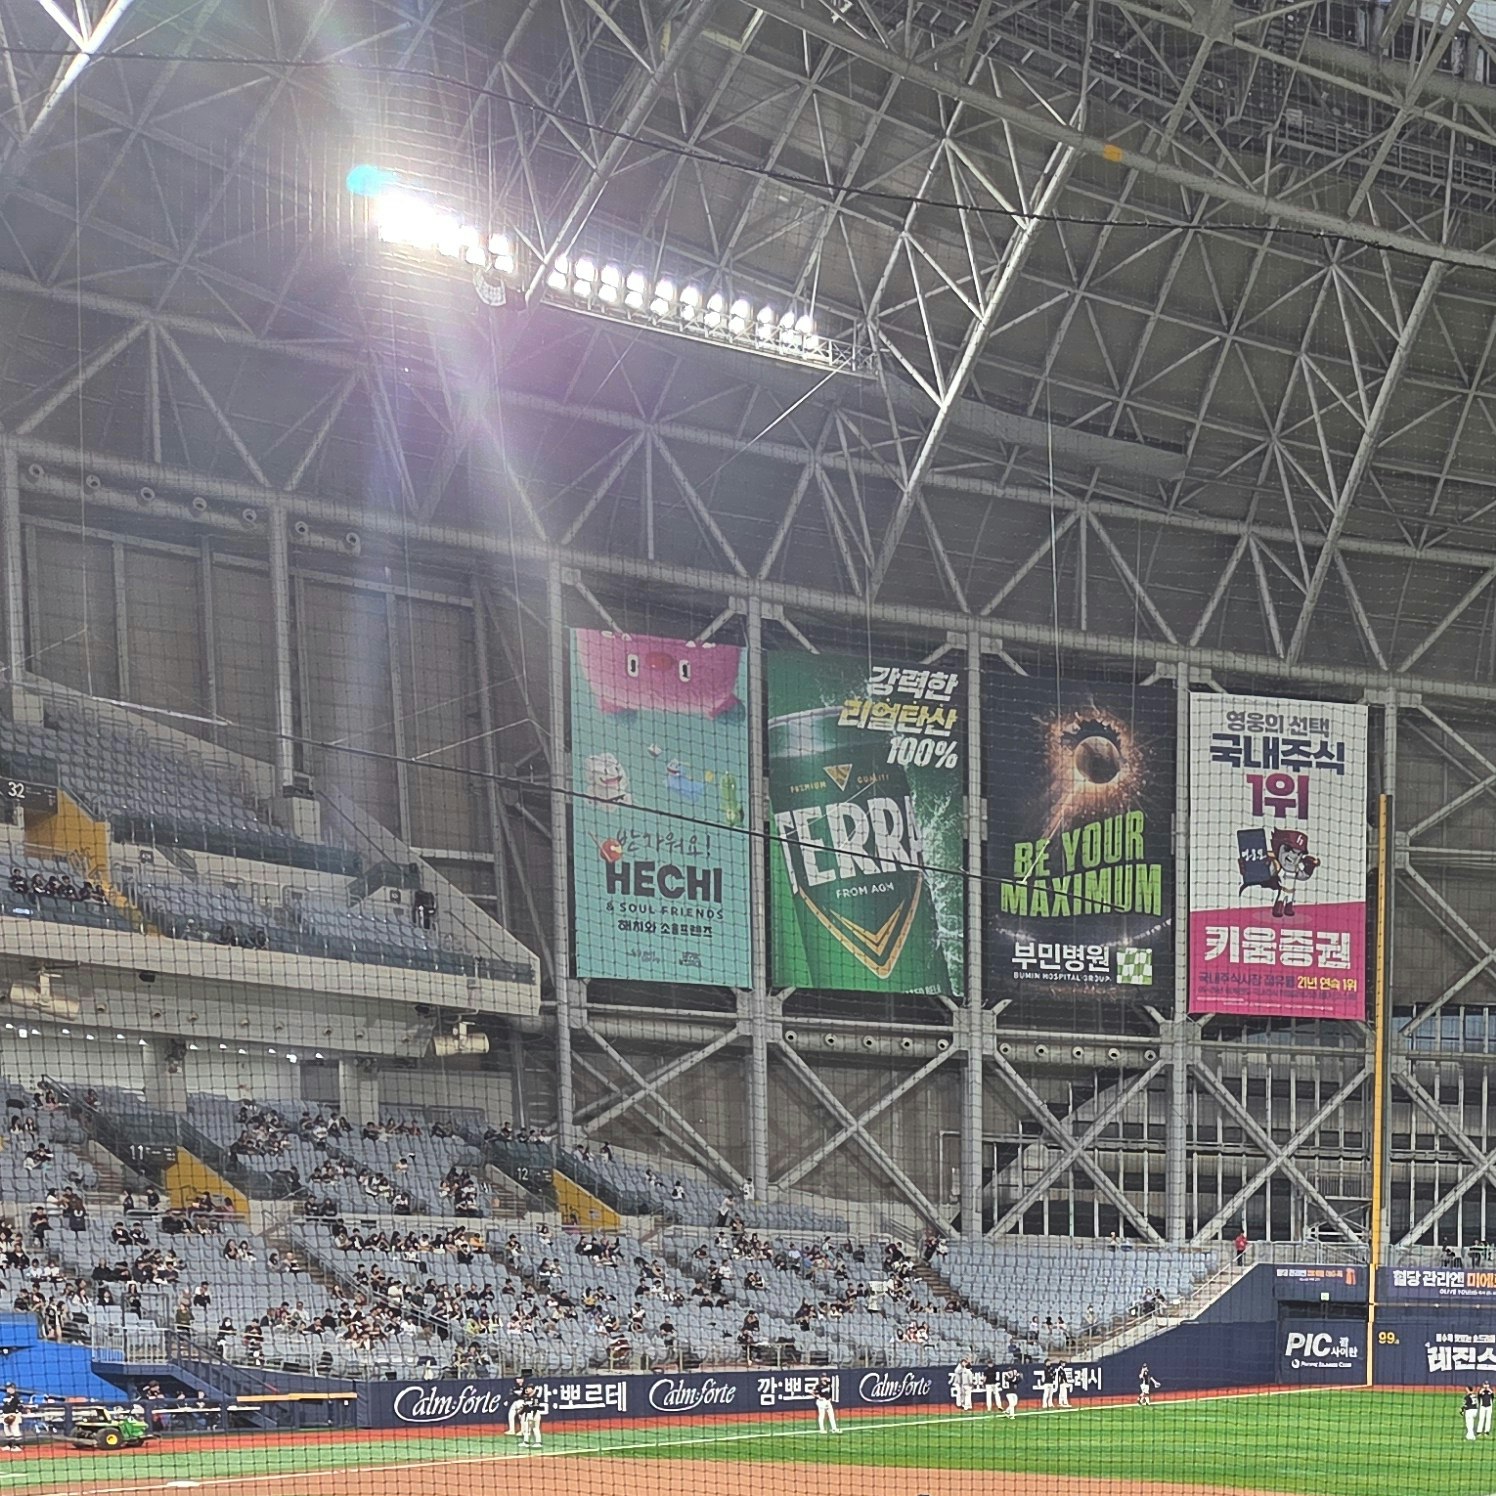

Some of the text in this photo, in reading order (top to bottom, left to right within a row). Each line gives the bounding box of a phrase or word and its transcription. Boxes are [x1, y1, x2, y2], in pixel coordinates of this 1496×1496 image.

[866, 665, 958, 702] 강력한
[838, 698, 957, 737] 리얼탄산
[1226, 710, 1329, 738] 영웅의 선택
[886, 736, 958, 769] 100%
[1210, 732, 1345, 776] 국내주식
[7, 781, 25, 798] 32
[1246, 772, 1310, 820] 1위
[774, 796, 922, 895] TERRA
[1014, 810, 1144, 878] BE YOUR
[606, 861, 723, 904] HECHI
[835, 889, 868, 899] FROM
[1000, 863, 1162, 918] MAXIMUM
[606, 902, 724, 920] & SOUL FRIENDS
[617, 919, 713, 938] 해치와 소울프렌즈
[1012, 942, 1110, 972] 부민병원
[1204, 925, 1351, 970] 키움증권
[517, 1168, 529, 1181] 12
[1393, 1270, 1421, 1287] 혈당
[1422, 1271, 1464, 1288] 관리엔
[1285, 1332, 1332, 1357] PIC
